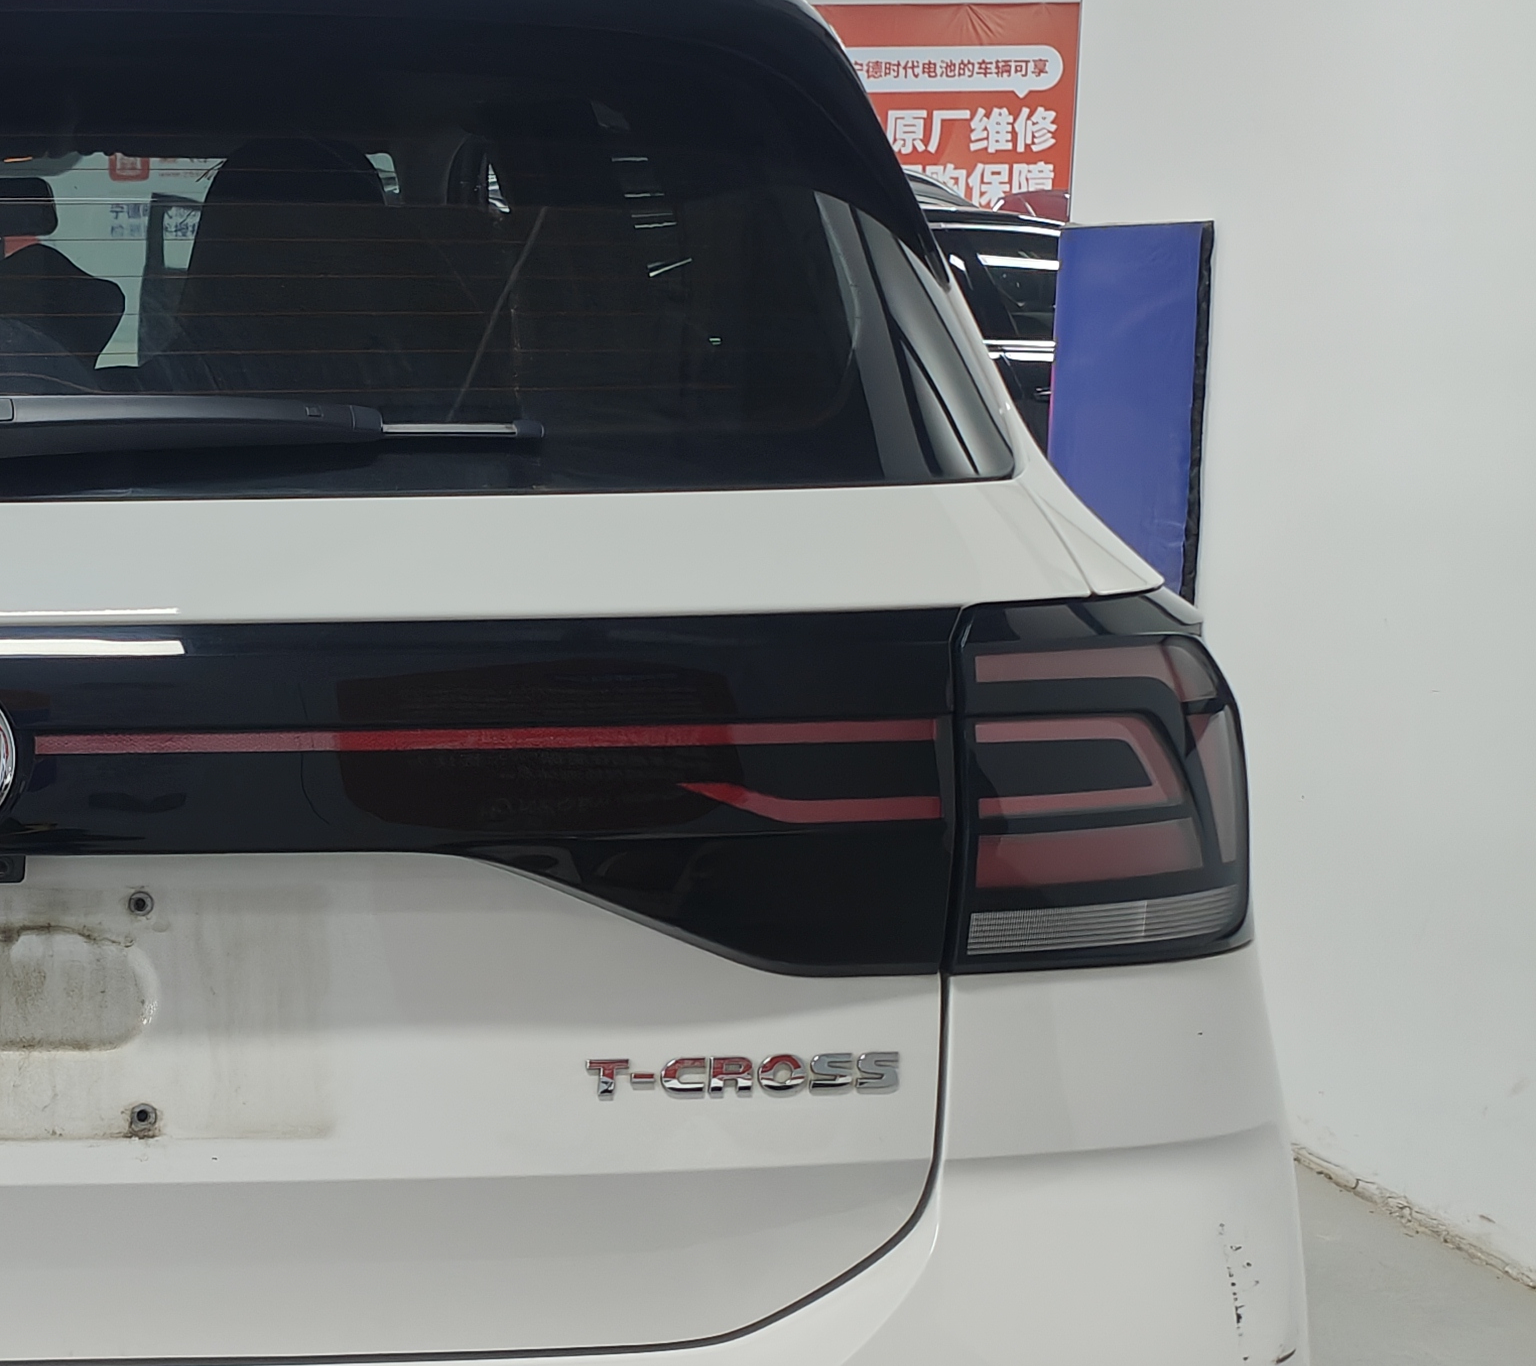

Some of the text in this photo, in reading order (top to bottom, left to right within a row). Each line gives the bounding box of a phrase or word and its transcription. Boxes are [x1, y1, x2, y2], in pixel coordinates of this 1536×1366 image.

[886, 107, 1058, 154] 原厂维修
[902, 161, 1055, 208] 购保障
[585, 1051, 900, 1101] T-CROSS
